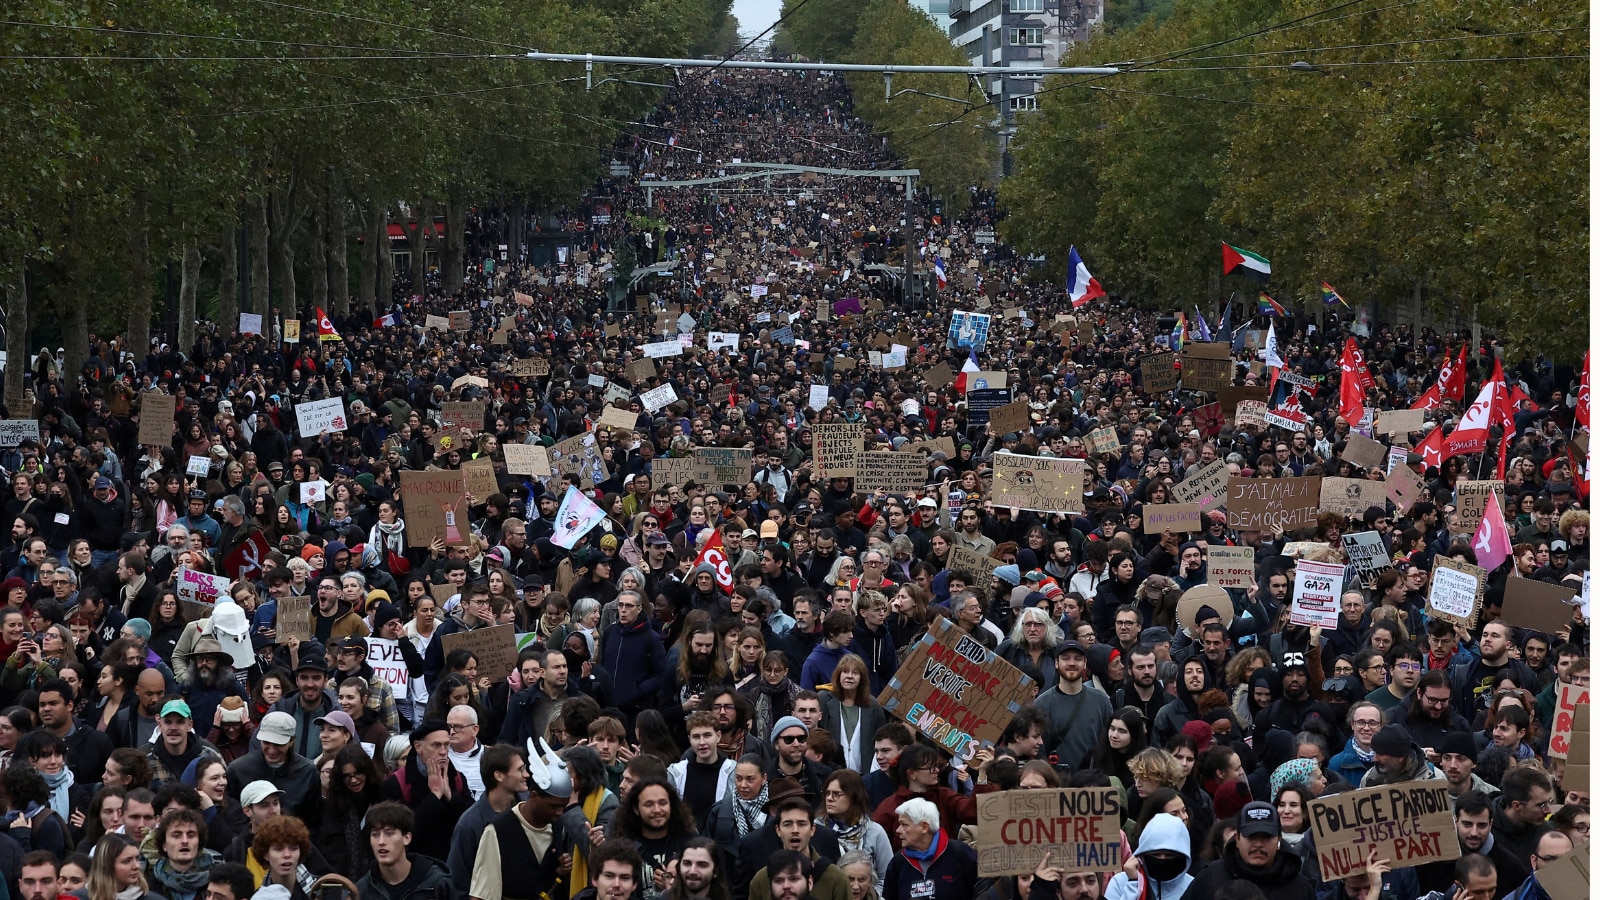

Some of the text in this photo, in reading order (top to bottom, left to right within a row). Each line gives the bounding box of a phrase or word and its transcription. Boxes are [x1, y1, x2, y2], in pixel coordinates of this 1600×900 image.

[813, 425, 847, 433] DEHORS
[818, 440, 852, 448] ABJECTS
[818, 455, 854, 463] HAINEUX
[818, 462, 854, 470] ORDURES
[402, 480, 462, 496] MACRONIE
[1234, 482, 1267, 500] J'AI
[1270, 482, 1296, 499] MAL
[1265, 500, 1283, 509] MA
[1465, 497, 1474, 507] ET
[1229, 506, 1317, 527] DÉMOCRATIE
[1344, 536, 1358, 546] LA
[1352, 557, 1373, 569] C'EST
[184, 570, 214, 588] BOSS
[1304, 580, 1330, 592] GAZA
[180, 588, 191, 598] SE
[103, 627, 114, 640] NY
[926, 641, 1000, 697] MACHOIRE
[922, 657, 973, 702] VERITE
[923, 689, 988, 737] BOUCHE
[905, 702, 981, 761] ENFANTS
[980, 791, 1120, 821] C'EST NOUS
[1388, 788, 1449, 820] PARTOUT
[1001, 816, 1103, 845] CONTRE
[1352, 817, 1422, 844] JUSTICE
[1393, 832, 1441, 861] PART
[979, 845, 1027, 873] CEUX
[1077, 842, 1120, 867] HAUT
